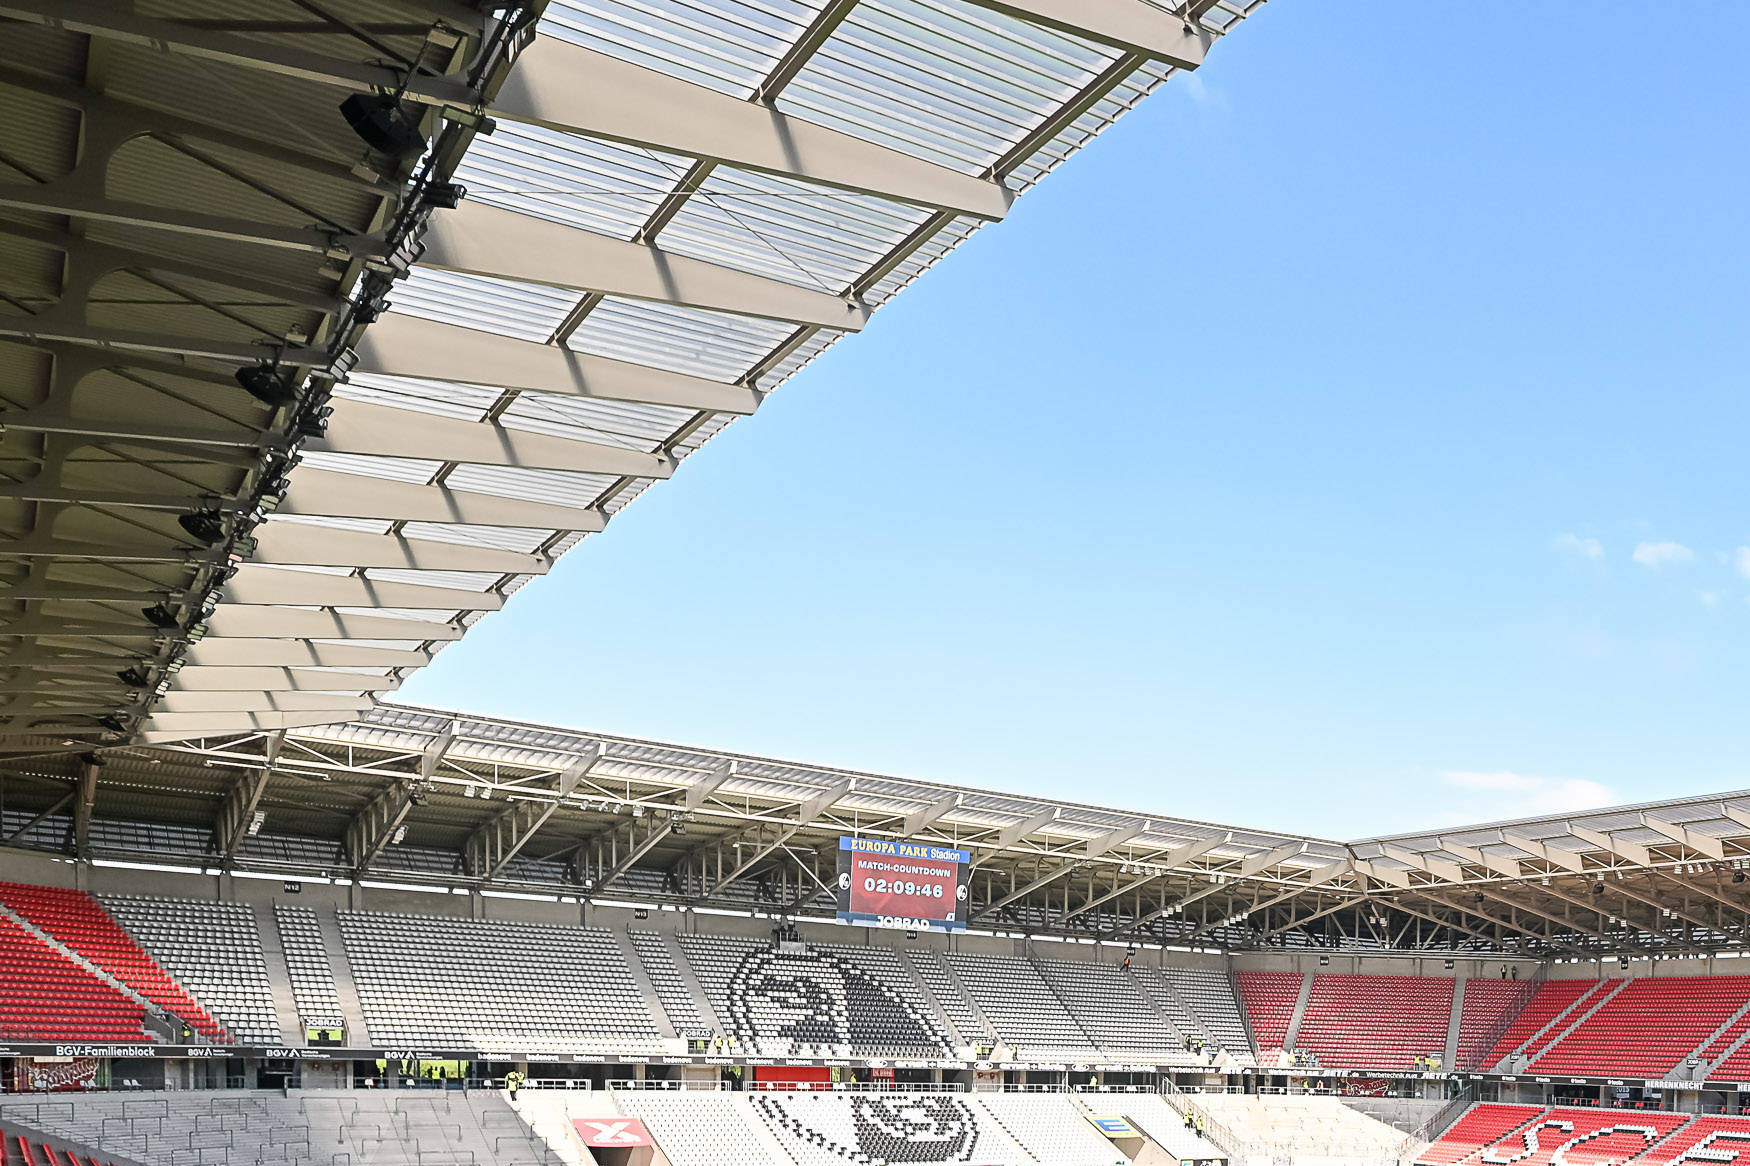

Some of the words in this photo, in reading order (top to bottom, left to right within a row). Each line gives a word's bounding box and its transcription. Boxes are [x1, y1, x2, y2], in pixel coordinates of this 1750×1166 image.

[851, 839, 896, 854] EUROPA
[900, 845, 928, 858] PARK
[931, 849, 960, 861] Stadion
[858, 860, 951, 878] MATCH-COUNTDOWN
[864, 877, 943, 898] 02:09:46
[876, 915, 930, 930] JOBRAD
[305, 1018, 343, 1027] JOBRAD
[56, 1045, 155, 1058] BGV-Familienblock
[188, 1048, 205, 1057] BGV
[266, 1049, 287, 1058] BGV
[384, 1051, 404, 1059] BGV
[1645, 1080, 1703, 1091] HERRENKNECHT
